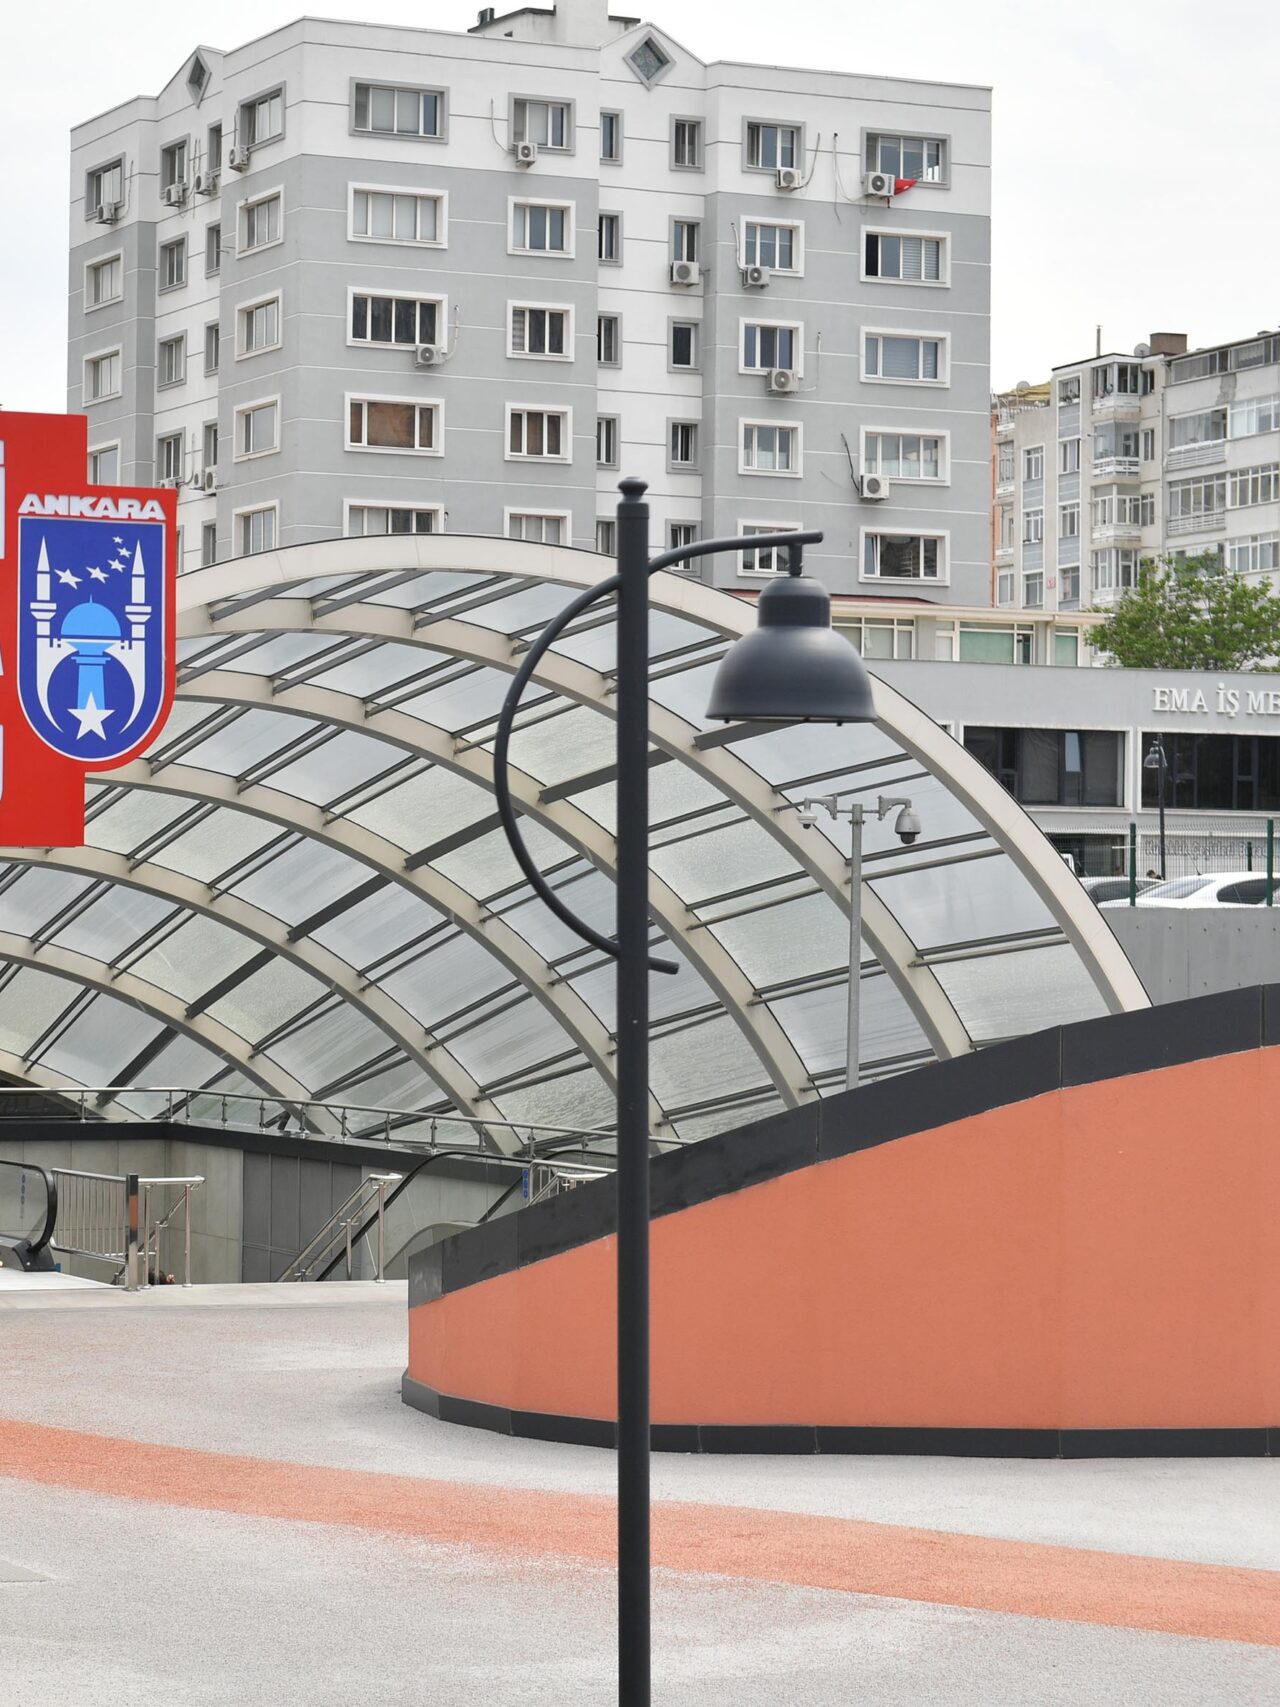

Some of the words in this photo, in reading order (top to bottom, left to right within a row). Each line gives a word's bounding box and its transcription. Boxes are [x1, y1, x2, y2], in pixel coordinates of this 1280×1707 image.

[17, 493, 167, 520] ANKARA
[1152, 687, 1209, 712] EMA
[1216, 682, 1240, 718] İŞ
